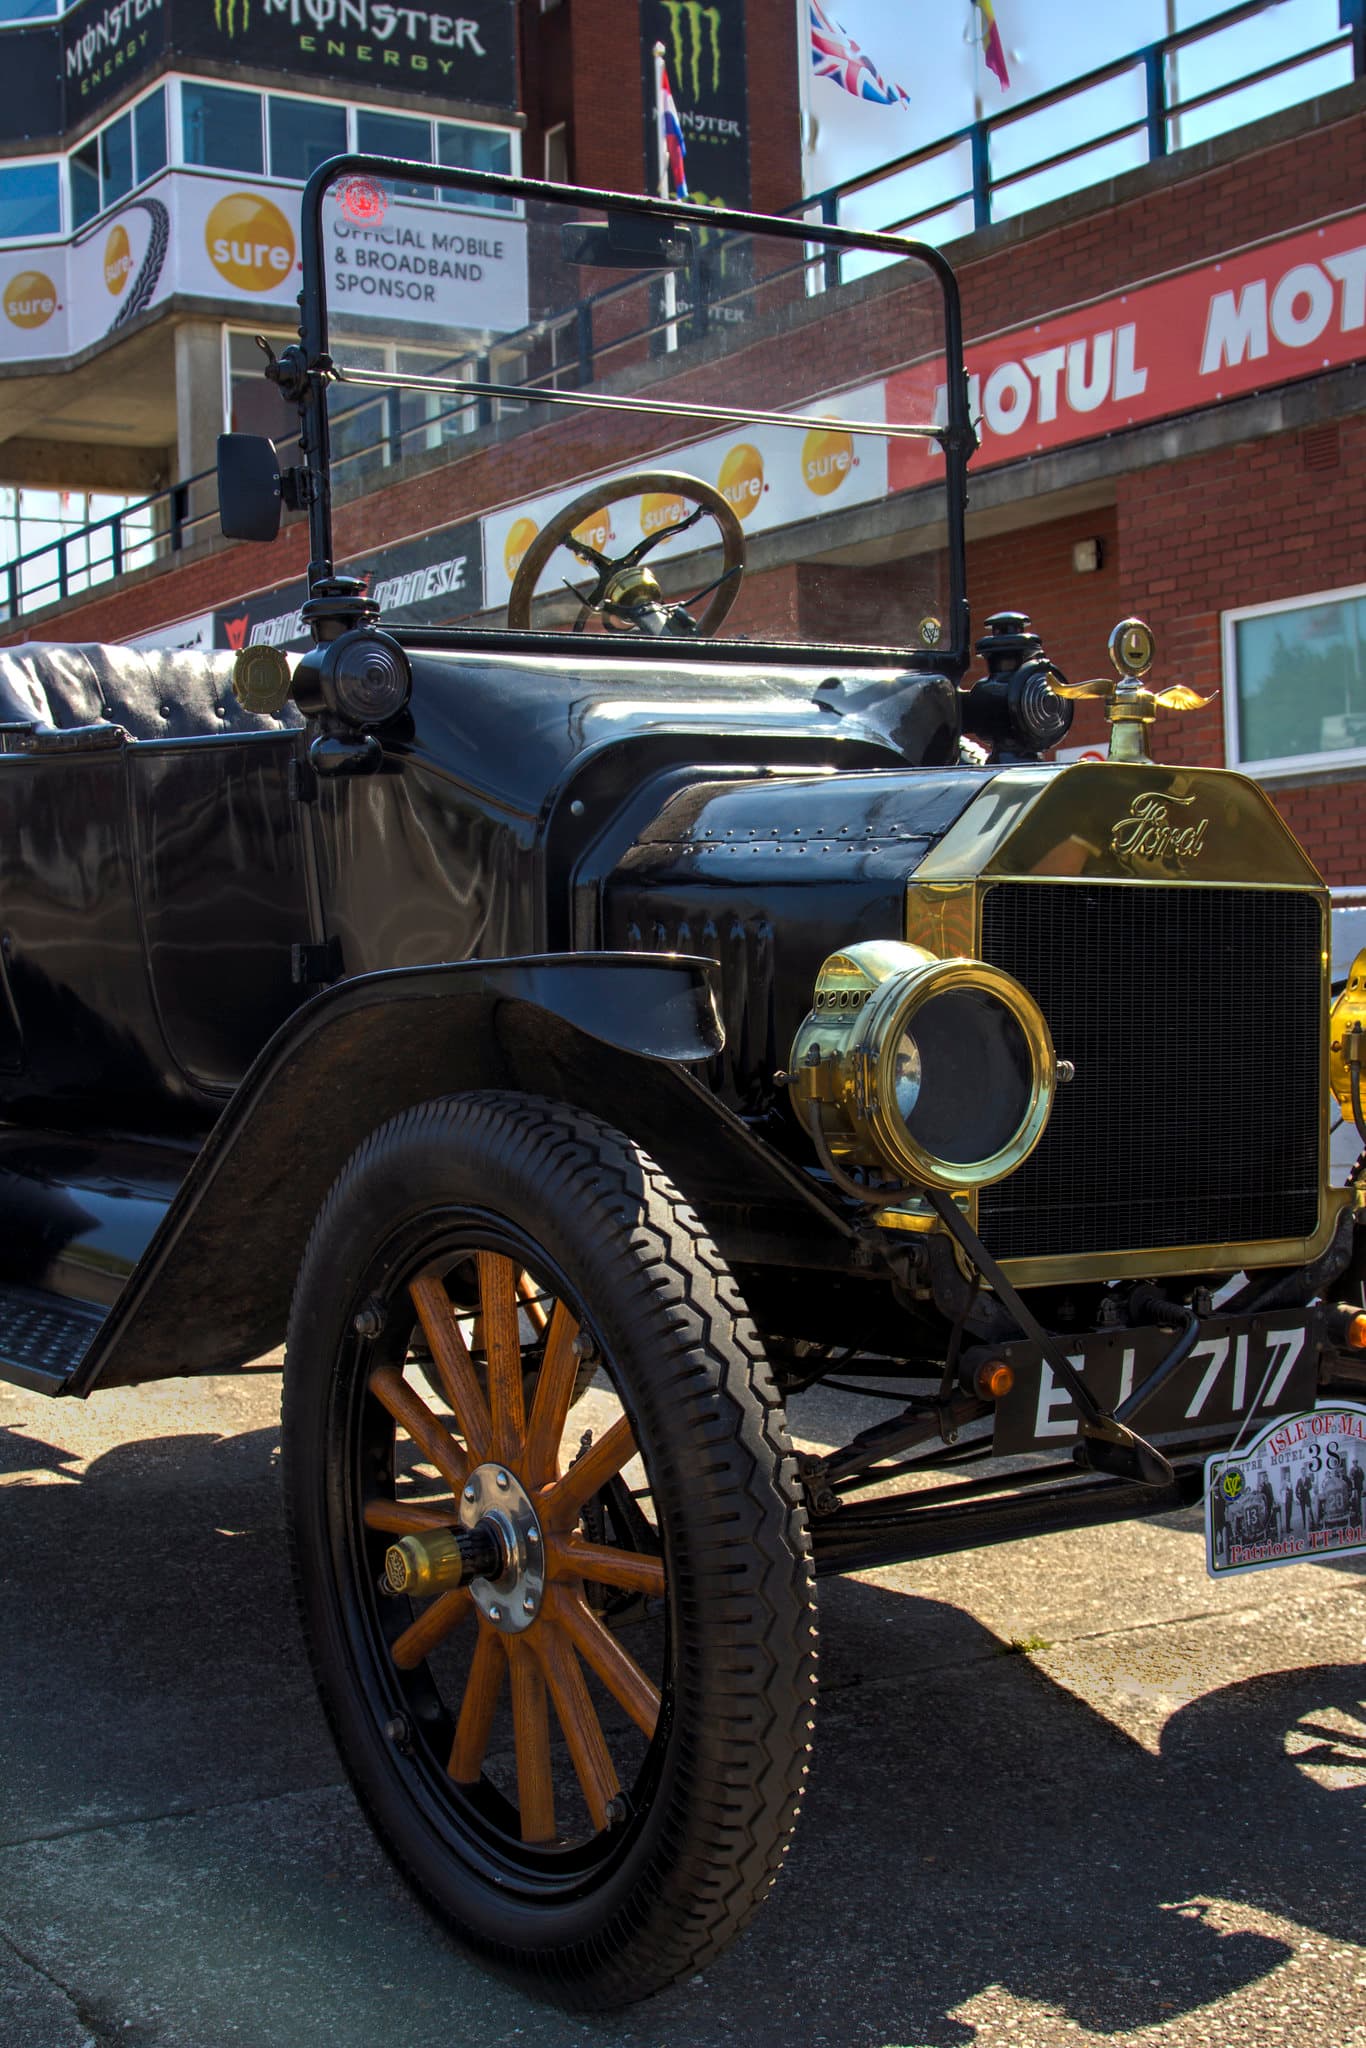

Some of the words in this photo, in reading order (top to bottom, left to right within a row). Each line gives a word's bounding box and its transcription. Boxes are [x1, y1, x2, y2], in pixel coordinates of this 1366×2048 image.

[80, 29, 149, 96] ENERGY
[300, 35, 455, 75] ENERGY
[432, 232, 503, 259] MOBILE
[335, 247, 348, 264] &
[355, 249, 483, 281] BROADBAND
[335, 272, 435, 302] SPONSOR
[1110, 792, 1209, 857] Ford
[1184, 1327, 1306, 1419] 717
[1267, 1421, 1308, 1456] ISLE
[1311, 1415, 1334, 1436] OF
[1271, 1450, 1305, 1466] HOTEL
[1308, 1441, 1342, 1472] 38
[1230, 1536, 1304, 1563] Patriotic
[1308, 1530, 1333, 1549] TT
